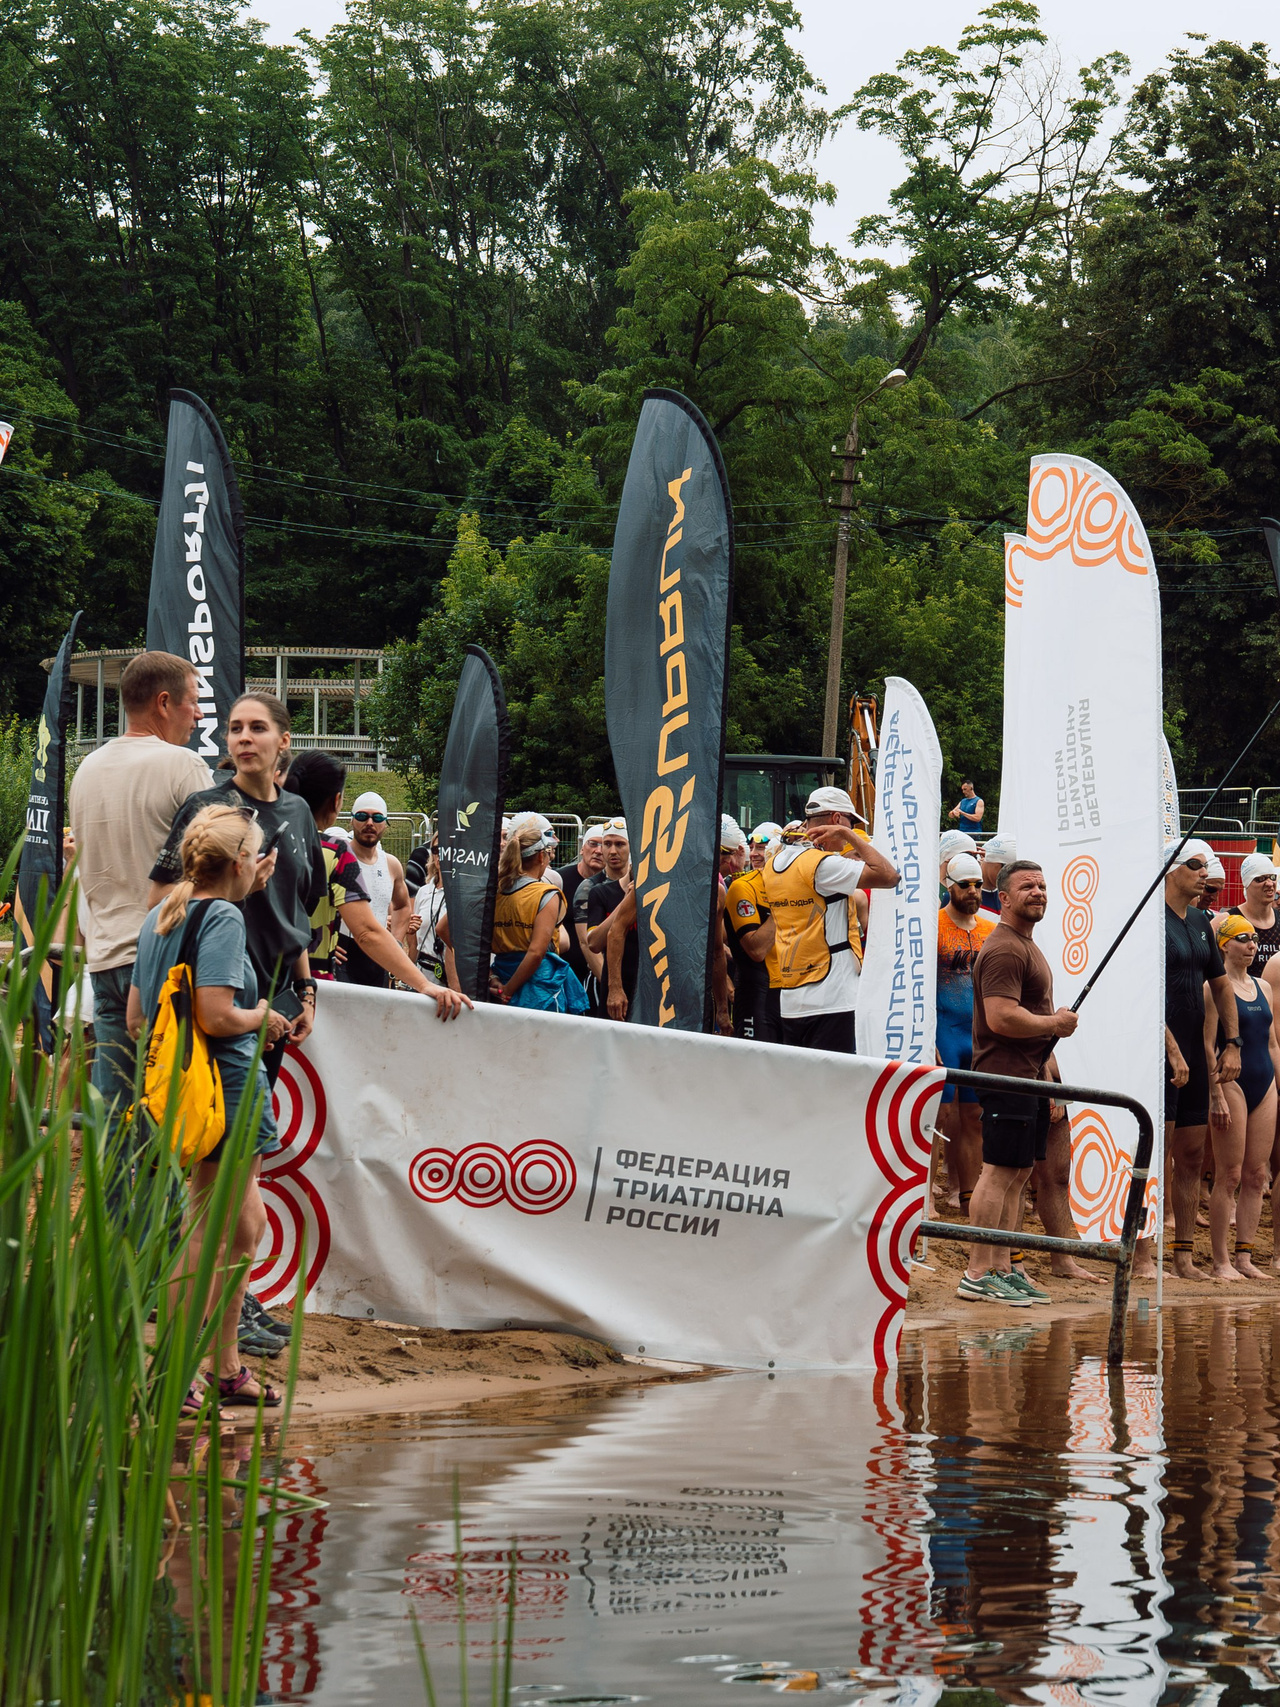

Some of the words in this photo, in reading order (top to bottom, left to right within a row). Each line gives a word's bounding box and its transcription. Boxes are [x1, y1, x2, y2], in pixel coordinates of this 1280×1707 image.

[743, 1016, 754, 1038] TR
[615, 1148, 791, 1190] ФЕДЕРАЦИЯ
[612, 1177, 785, 1219] ТРИАТЛОНА
[606, 1205, 721, 1238] РОССИИ
